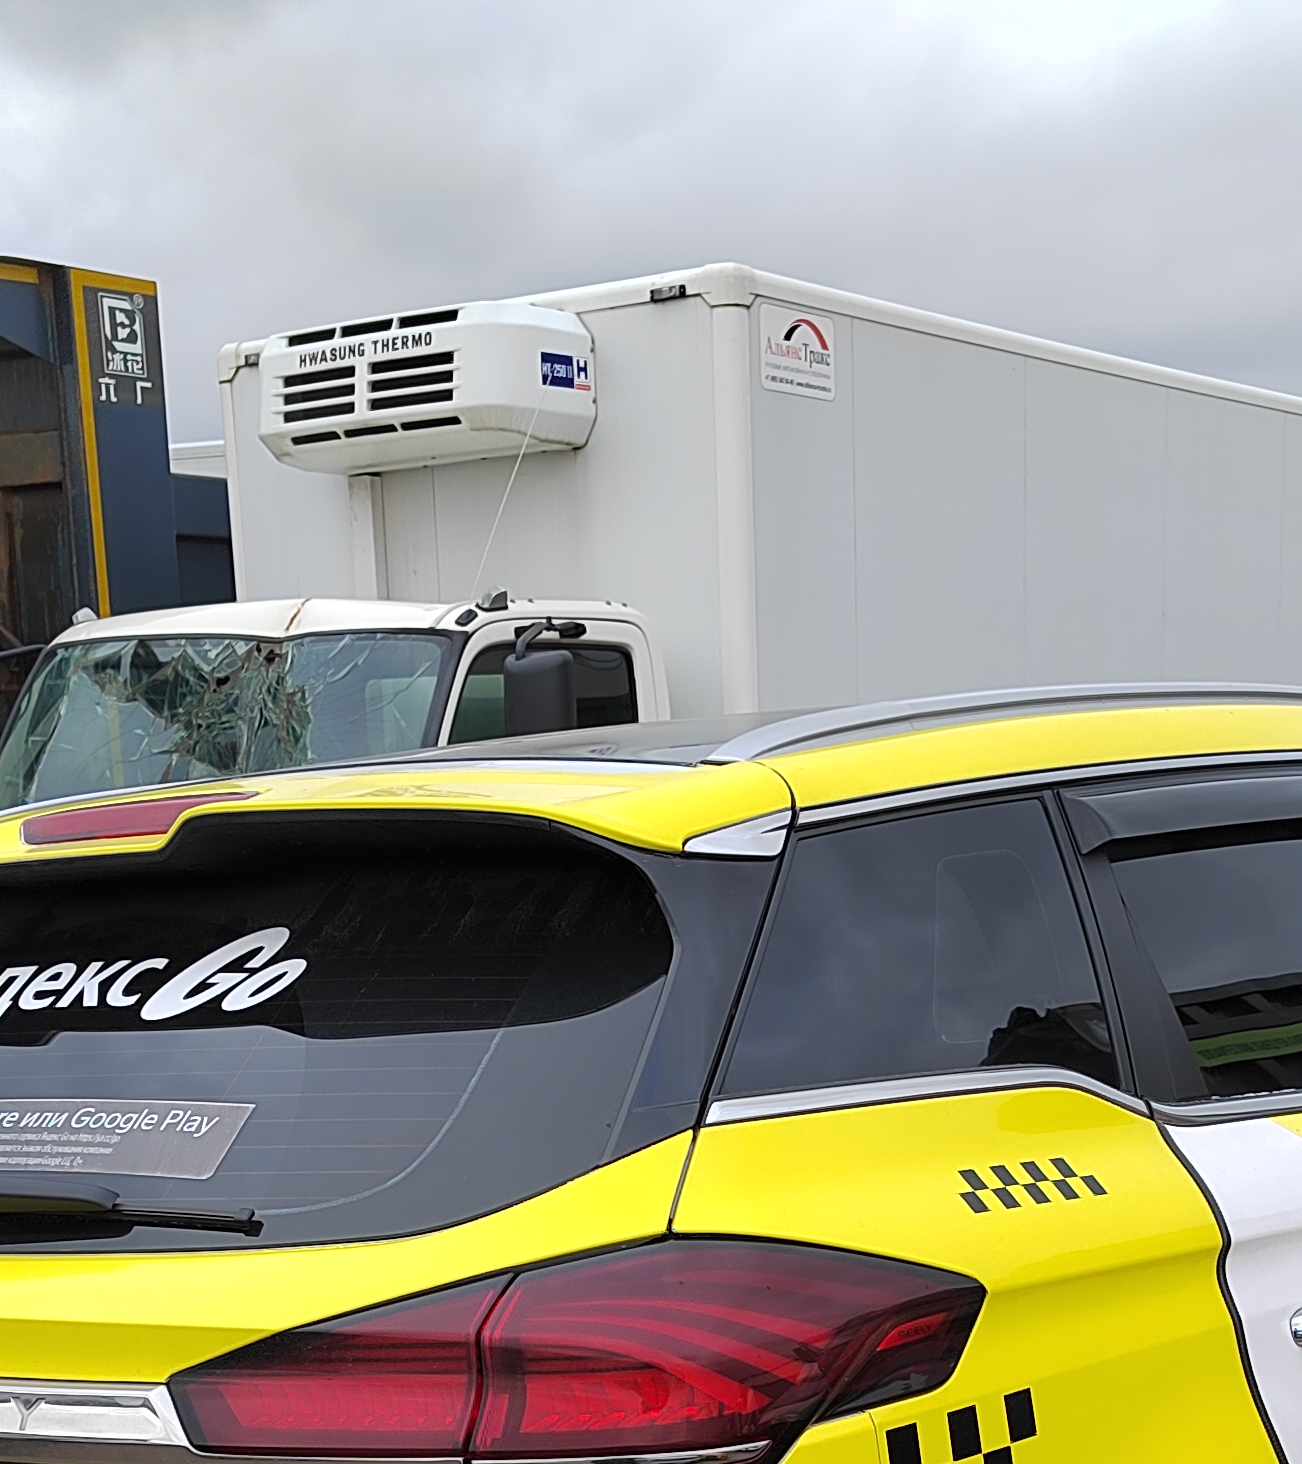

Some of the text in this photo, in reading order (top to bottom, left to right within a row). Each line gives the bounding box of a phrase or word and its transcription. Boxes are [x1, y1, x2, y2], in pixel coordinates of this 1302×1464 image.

[299, 331, 432, 368] HWASUNG THERMO
[140, 927, 307, 1021] Go
[18, 1110, 69, 1128] или
[70, 1107, 158, 1133] Google
[159, 1109, 219, 1138] Play
